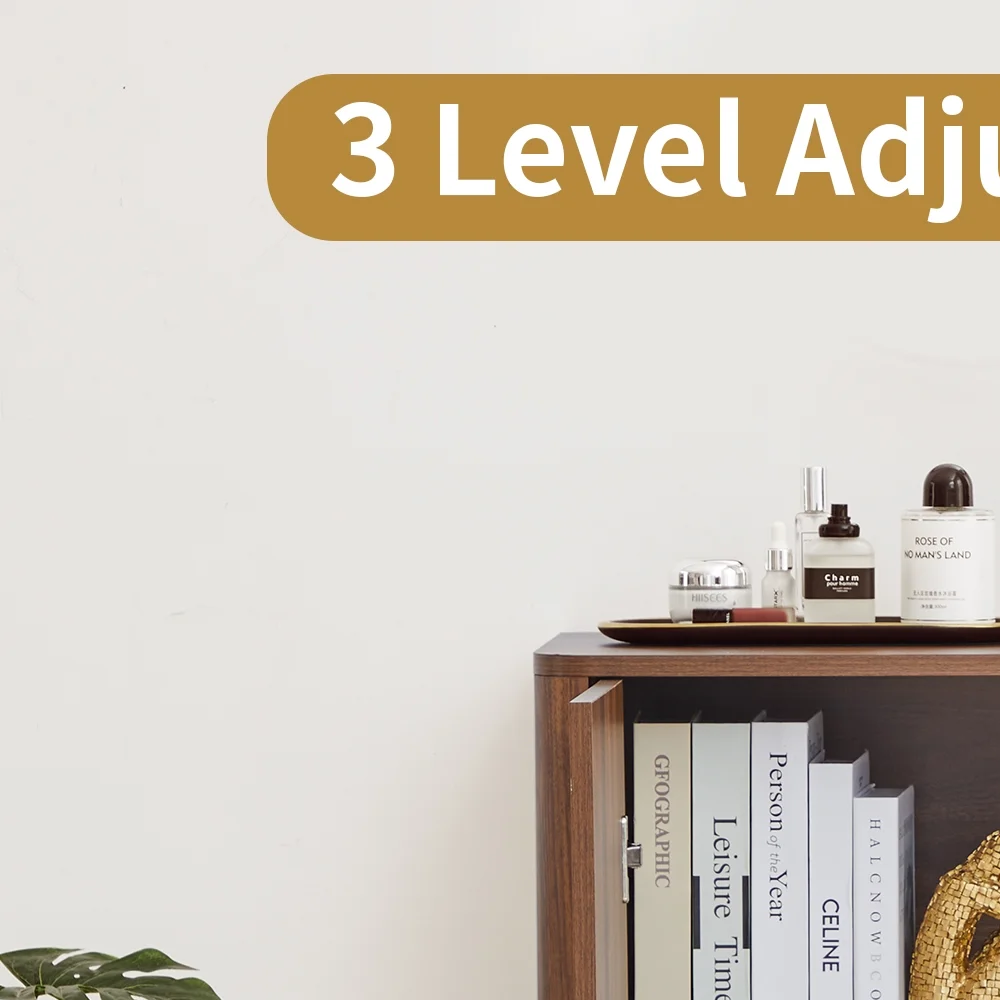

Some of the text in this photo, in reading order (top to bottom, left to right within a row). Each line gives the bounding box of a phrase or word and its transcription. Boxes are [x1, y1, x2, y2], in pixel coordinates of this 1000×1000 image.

[914, 550, 942, 560] MAN'S
[944, 550, 972, 560] LAND
[915, 536, 954, 546] ROSE OF
[824, 573, 860, 582] Charm
[766, 752, 788, 921] Person of the Year
[713, 816, 738, 919] Leisure
[822, 898, 840, 973] CELINE
